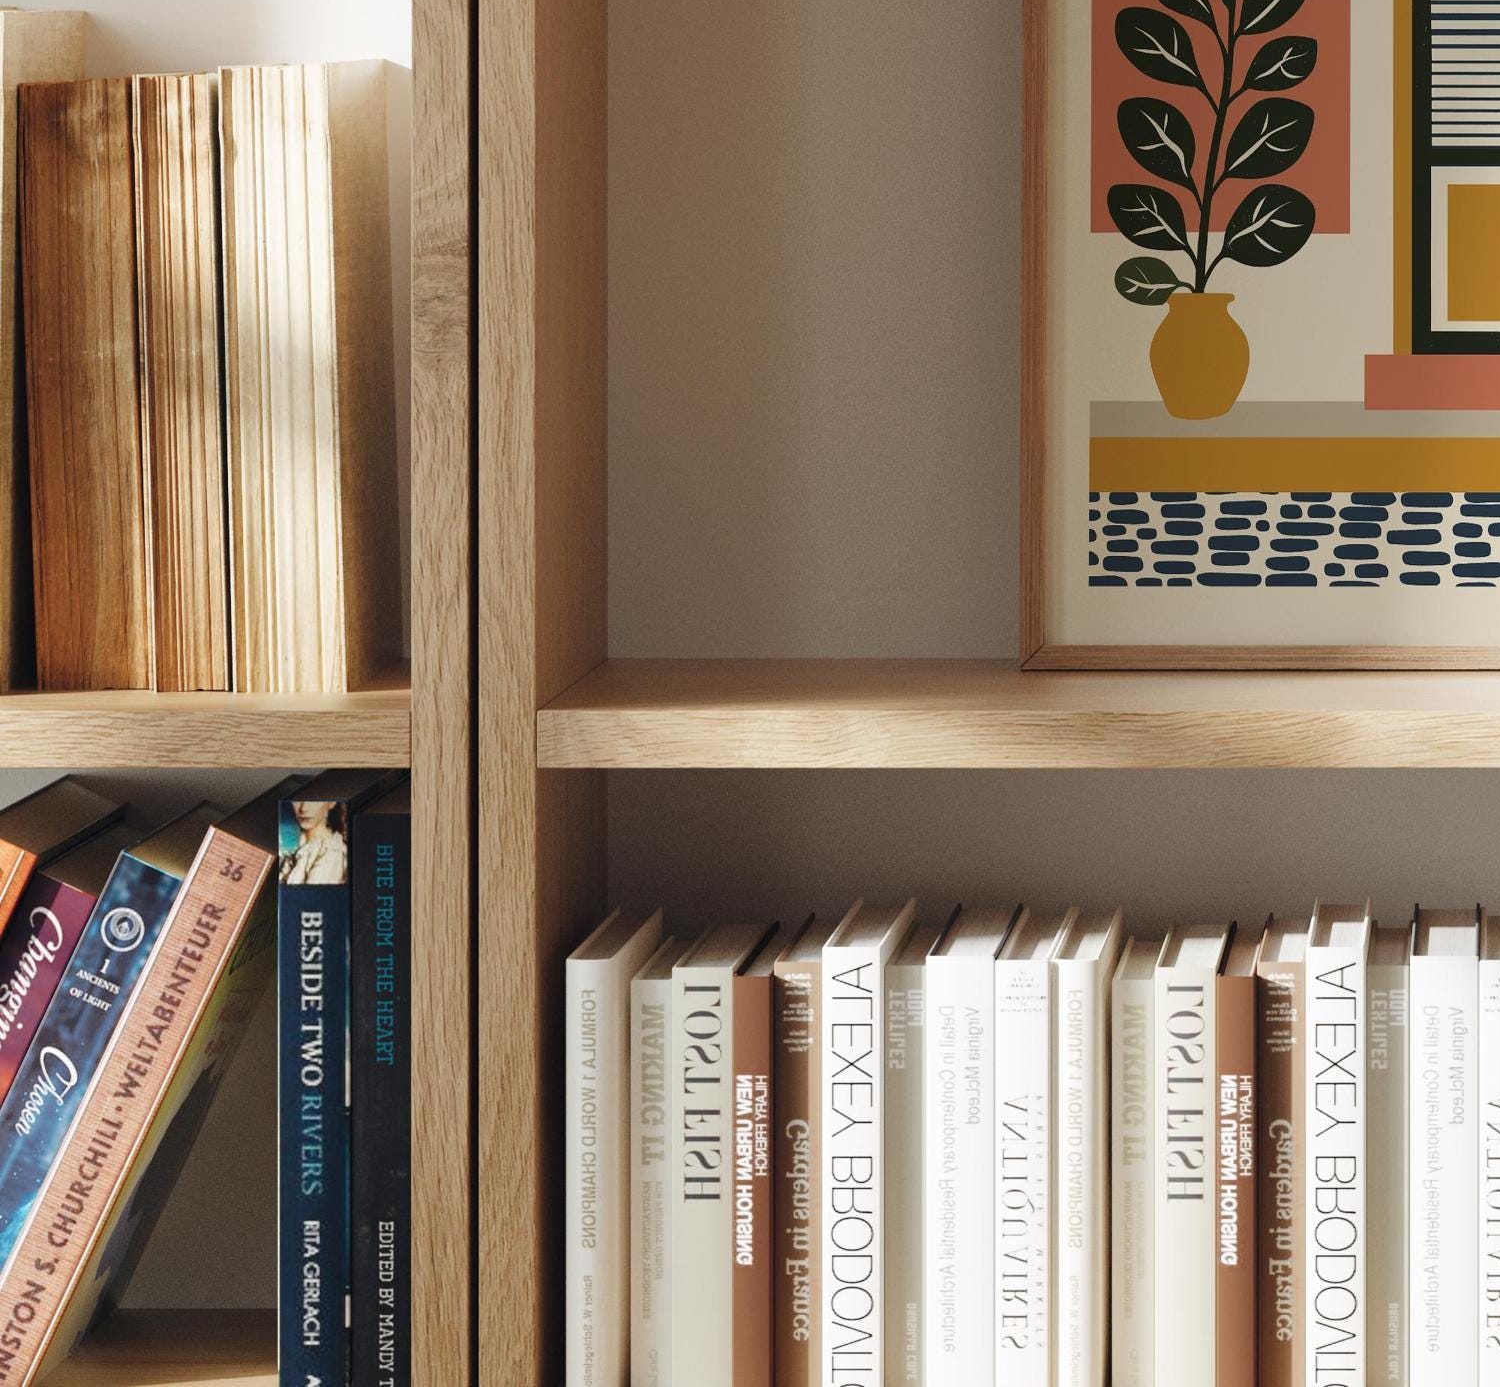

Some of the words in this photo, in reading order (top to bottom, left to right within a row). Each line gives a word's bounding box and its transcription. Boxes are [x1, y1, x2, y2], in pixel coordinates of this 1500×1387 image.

[377, 844, 393, 888] BITE
[377, 896, 393, 946] FROM
[76, 969, 120, 995] ANCIENTS
[99, 959, 110, 973] 1
[301, 912, 323, 1011] BESIDE
[377, 952, 393, 990] THE
[70, 987, 83, 999] OF
[84, 992, 112, 1013] LIGHT
[301, 1018, 323, 1088] TWO
[377, 994, 393, 1065] HEART
[15, 1046, 79, 1138] Chosen
[47, 1123, 123, 1251] CHURCHILL
[116, 902, 226, 1100] WELTABENTEUER
[301, 1095, 323, 1197] RIVERS
[303, 1221, 320, 1259] RITA
[378, 1221, 394, 1281] EDITED
[303, 1265, 320, 1347] GERLACH
[378, 1288, 394, 1309] BY
[378, 1315, 394, 1371] MANDY
